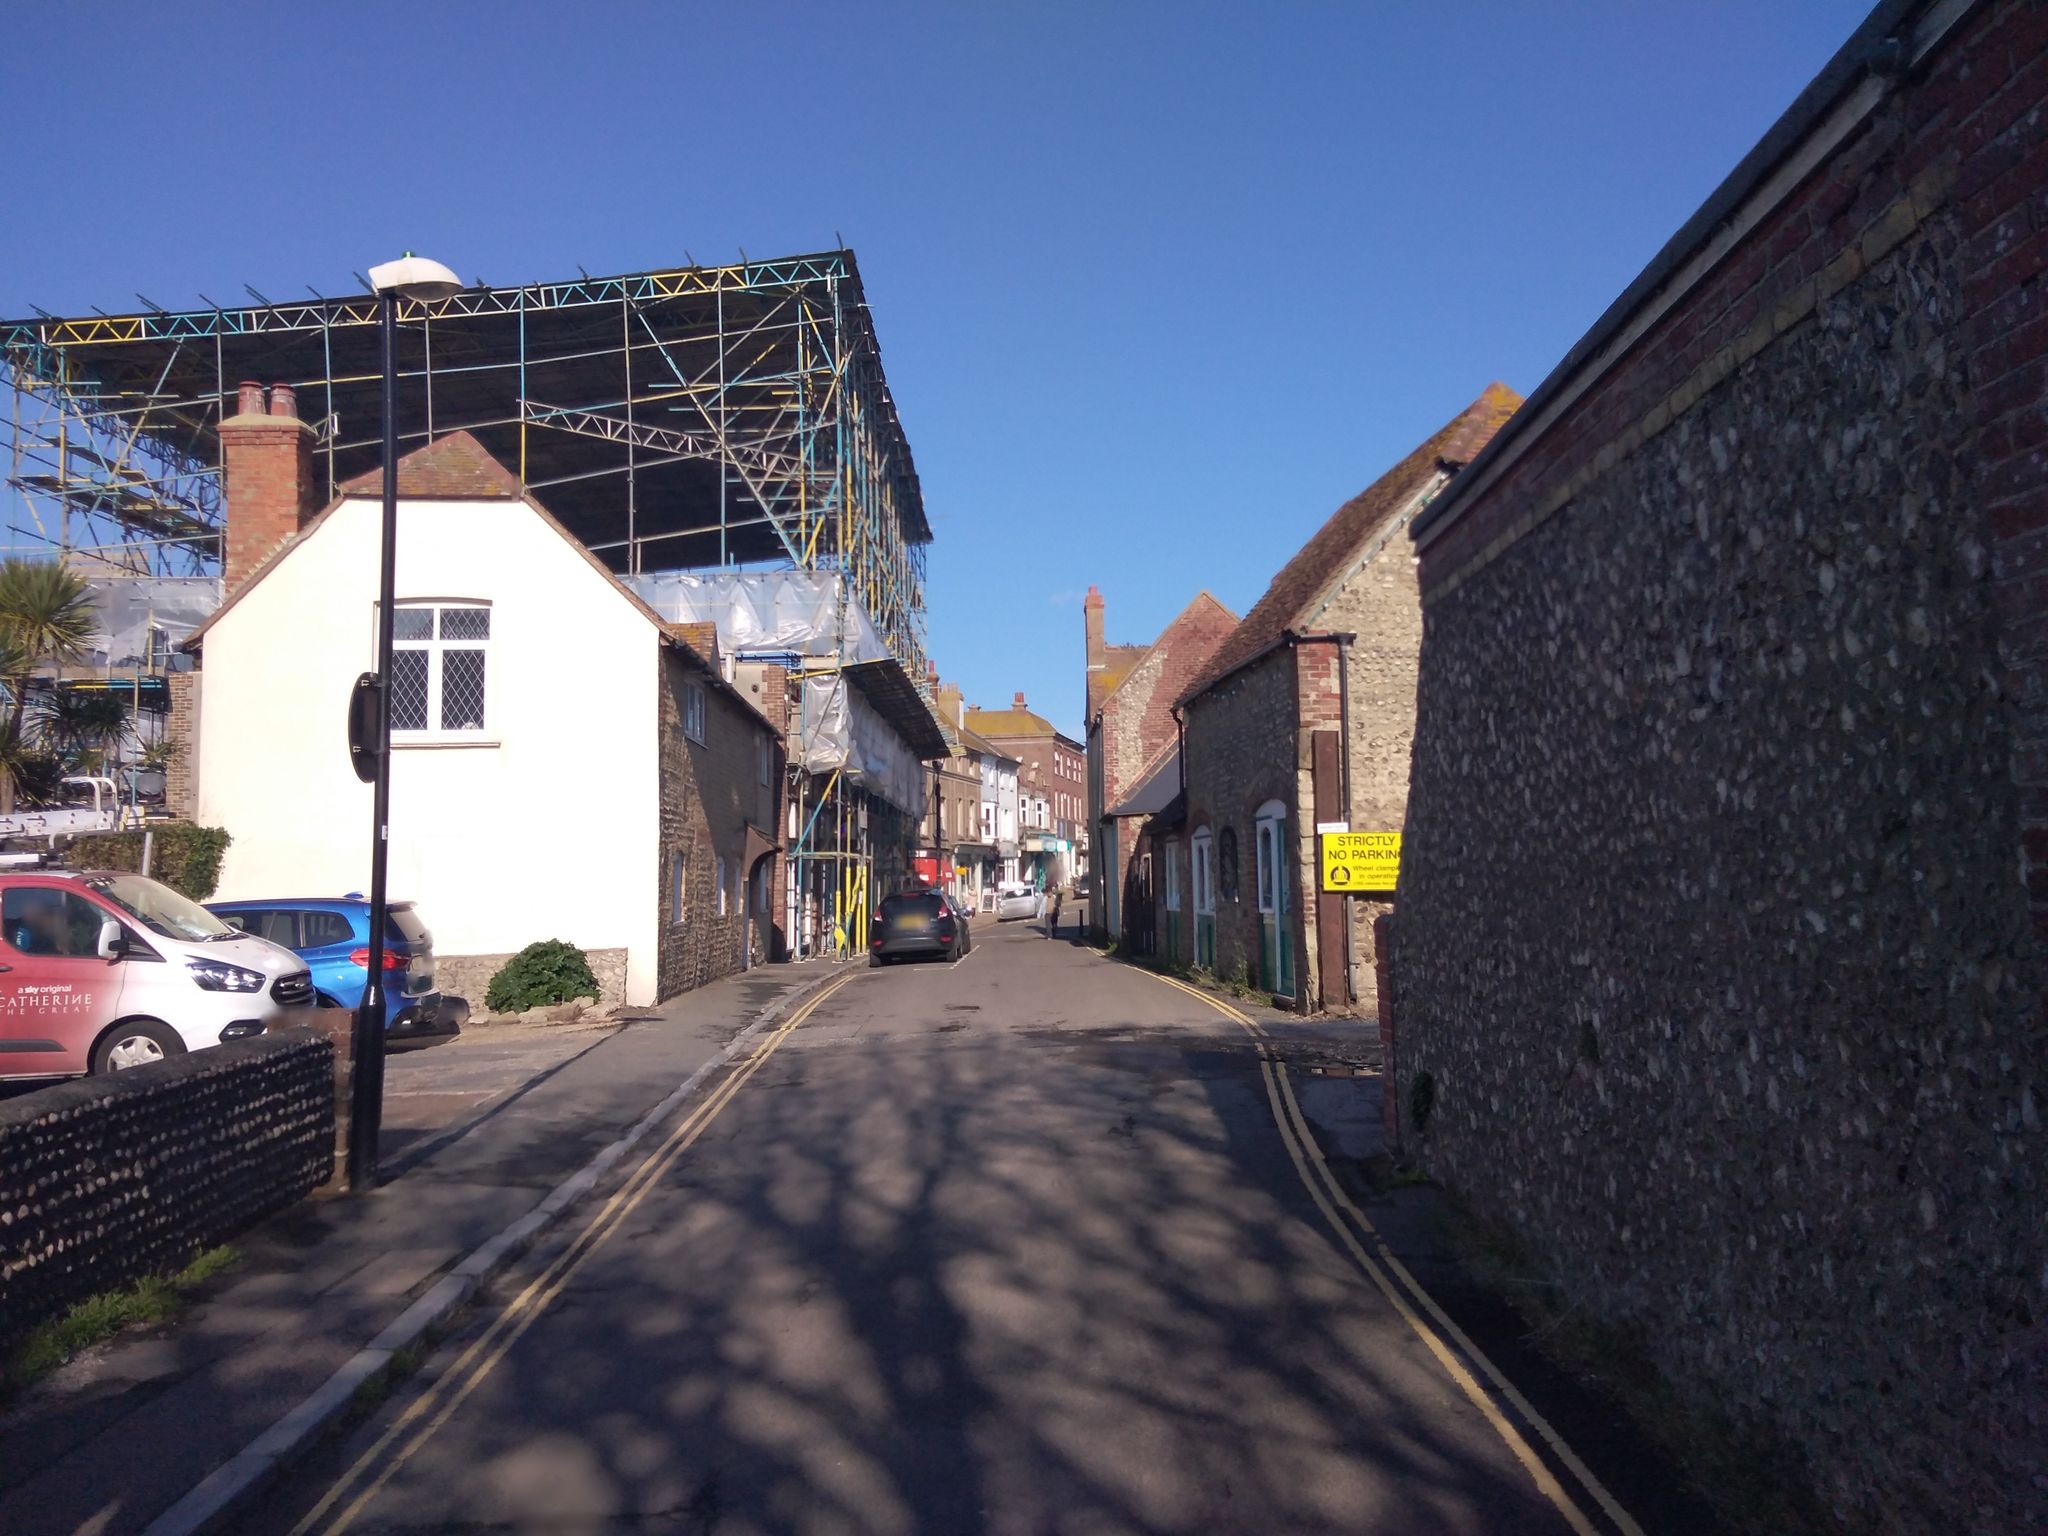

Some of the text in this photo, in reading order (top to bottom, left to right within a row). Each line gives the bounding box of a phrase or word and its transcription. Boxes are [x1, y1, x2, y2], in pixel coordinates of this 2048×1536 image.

[1337, 835, 1396, 846] STRICTLY
[1328, 849, 1348, 860] NO
[24, 985, 40, 995] sky
[40, 984, 72, 995] original
[0, 1006, 91, 1016] HE GREAT
